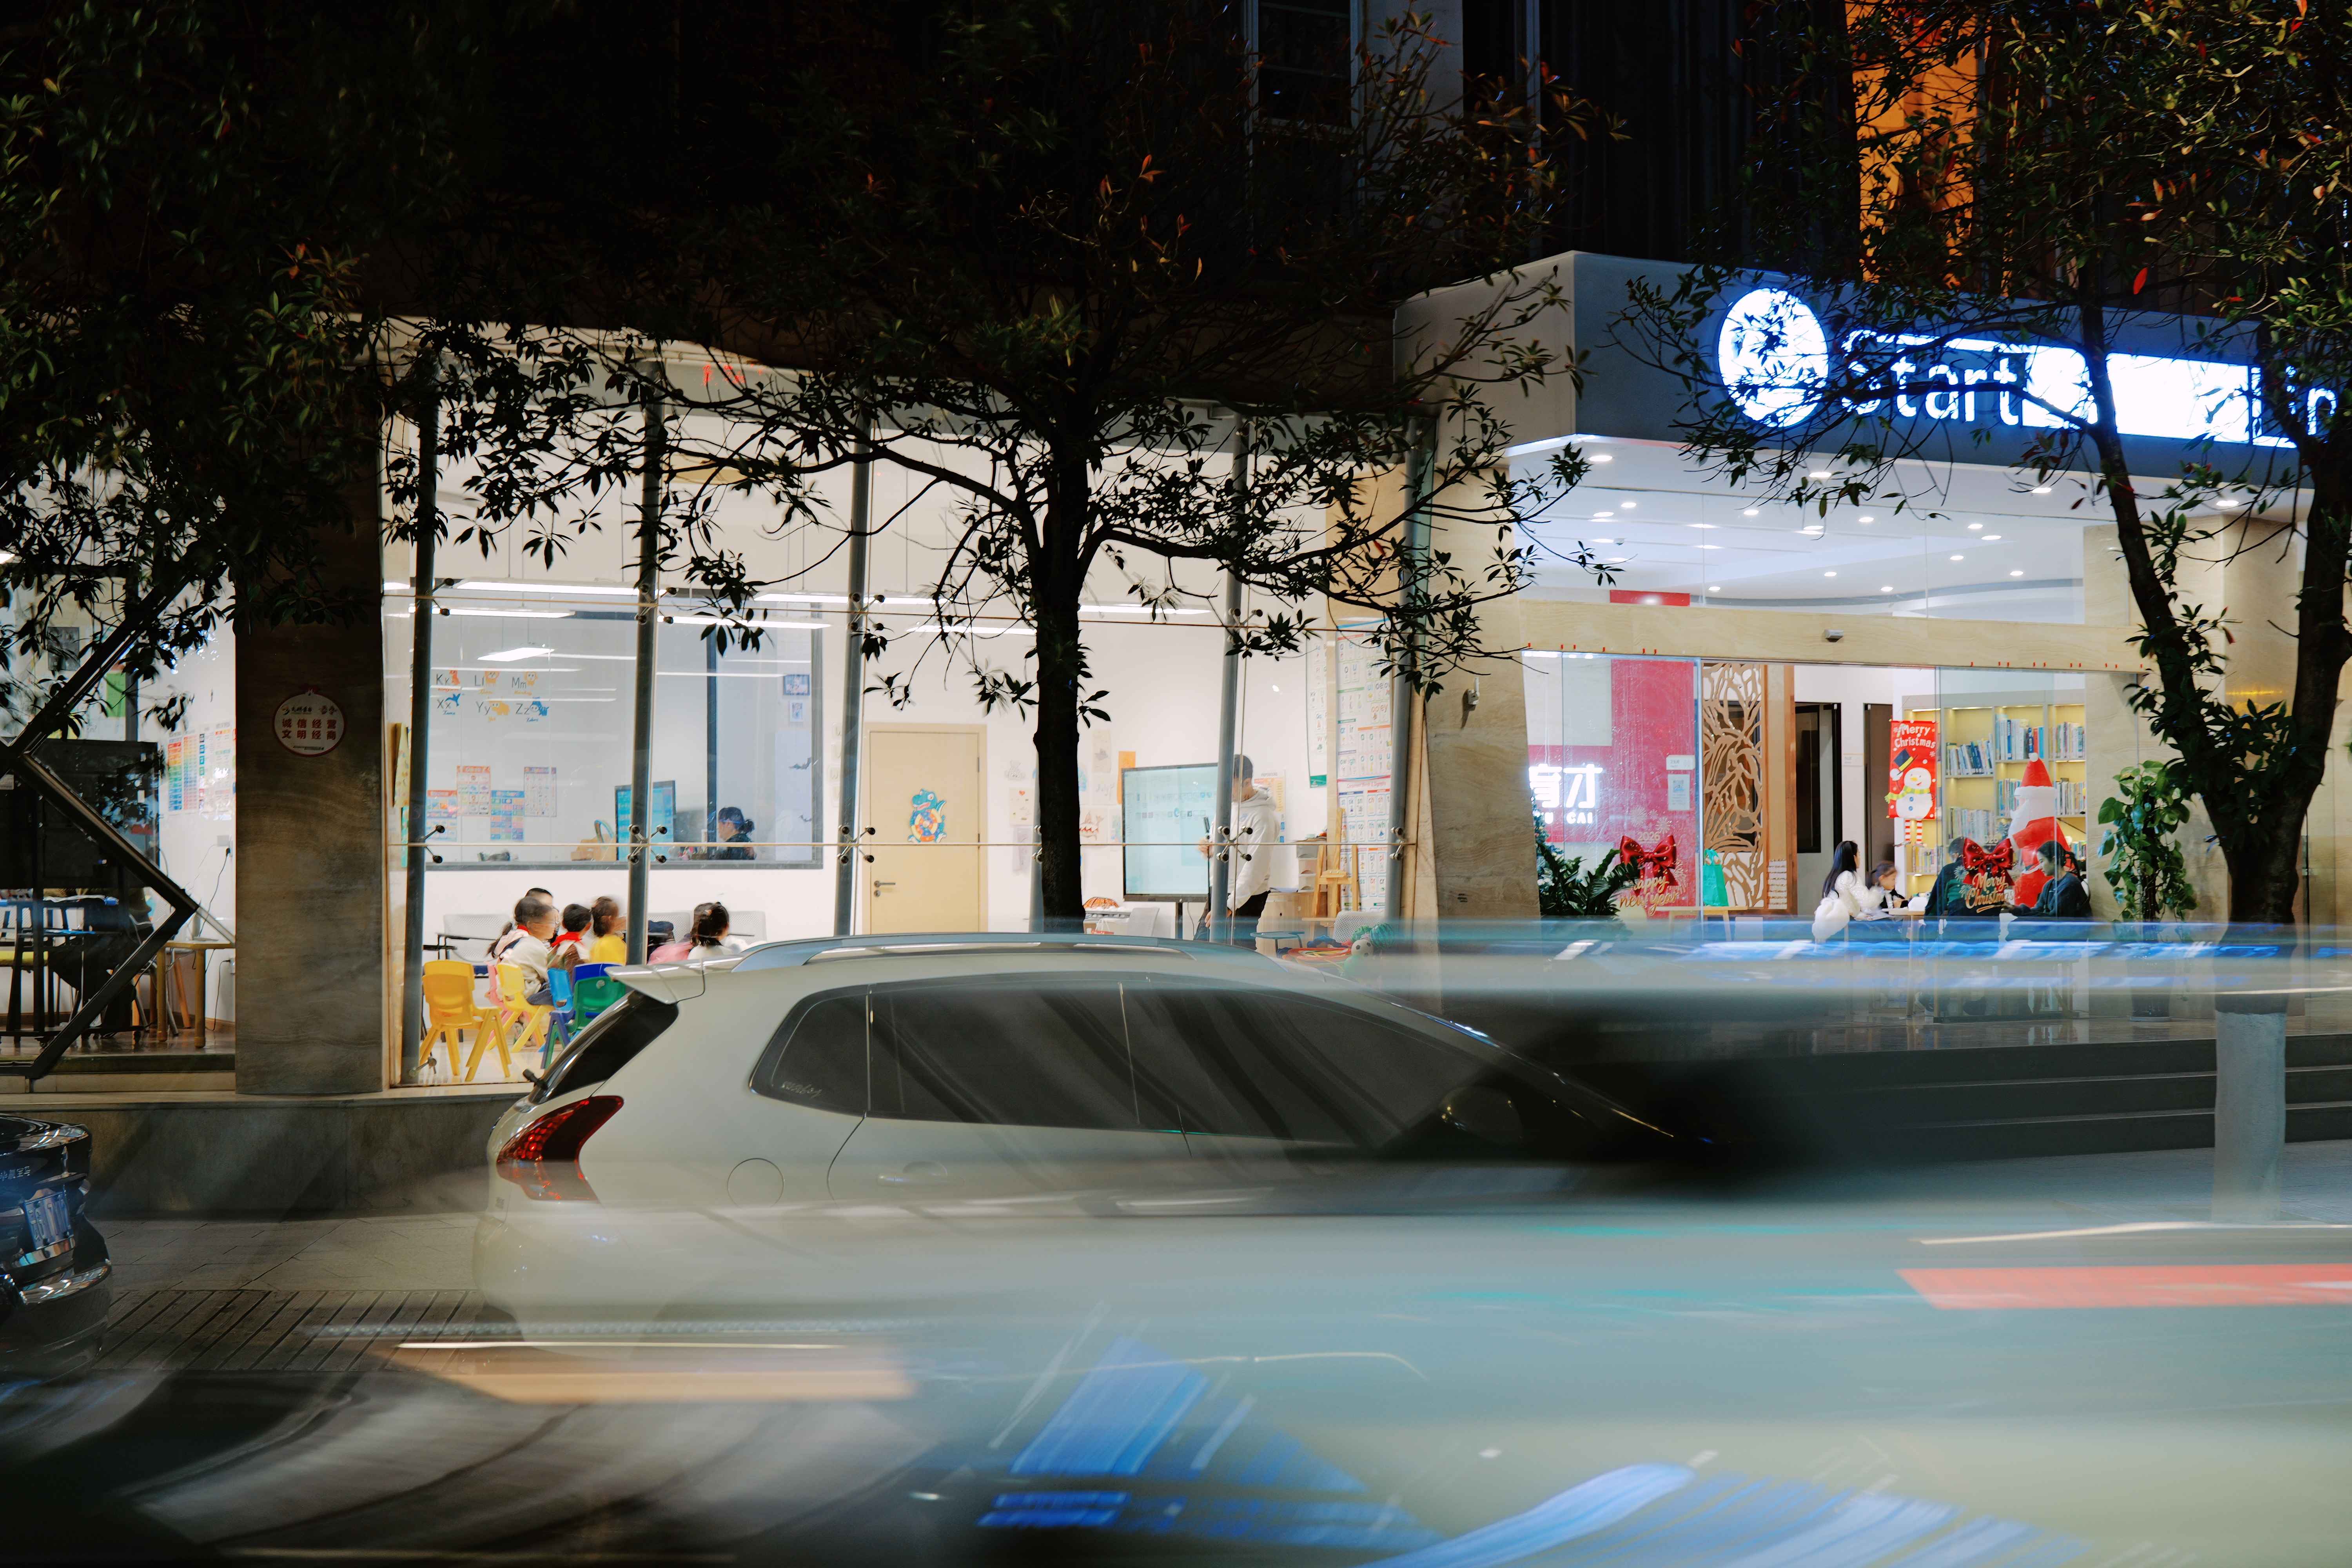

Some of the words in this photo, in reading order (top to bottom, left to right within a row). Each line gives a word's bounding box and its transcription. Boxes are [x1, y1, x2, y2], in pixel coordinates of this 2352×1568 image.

[1841, 329, 2019, 426] Start
[512, 677, 527, 689] Mm
[437, 699, 451, 709] Xx
[475, 701, 491, 715] Yy
[515, 703, 530, 715] Zz
[282, 718, 337, 729] 诚信经营
[1897, 723, 1931, 738] Merry
[282, 729, 336, 740] 文明经商
[1894, 737, 1936, 749] Christmas
[1528, 763, 1603, 808] 育才
[1566, 812, 1593, 824] CAI
[1637, 831, 1660, 841] 2026
[1633, 876, 1670, 894] appy
[1972, 872, 2009, 892] Merry
[1619, 893, 1648, 908] new
[1648, 892, 1679, 916] year
[1965, 887, 2014, 909] Christmas
